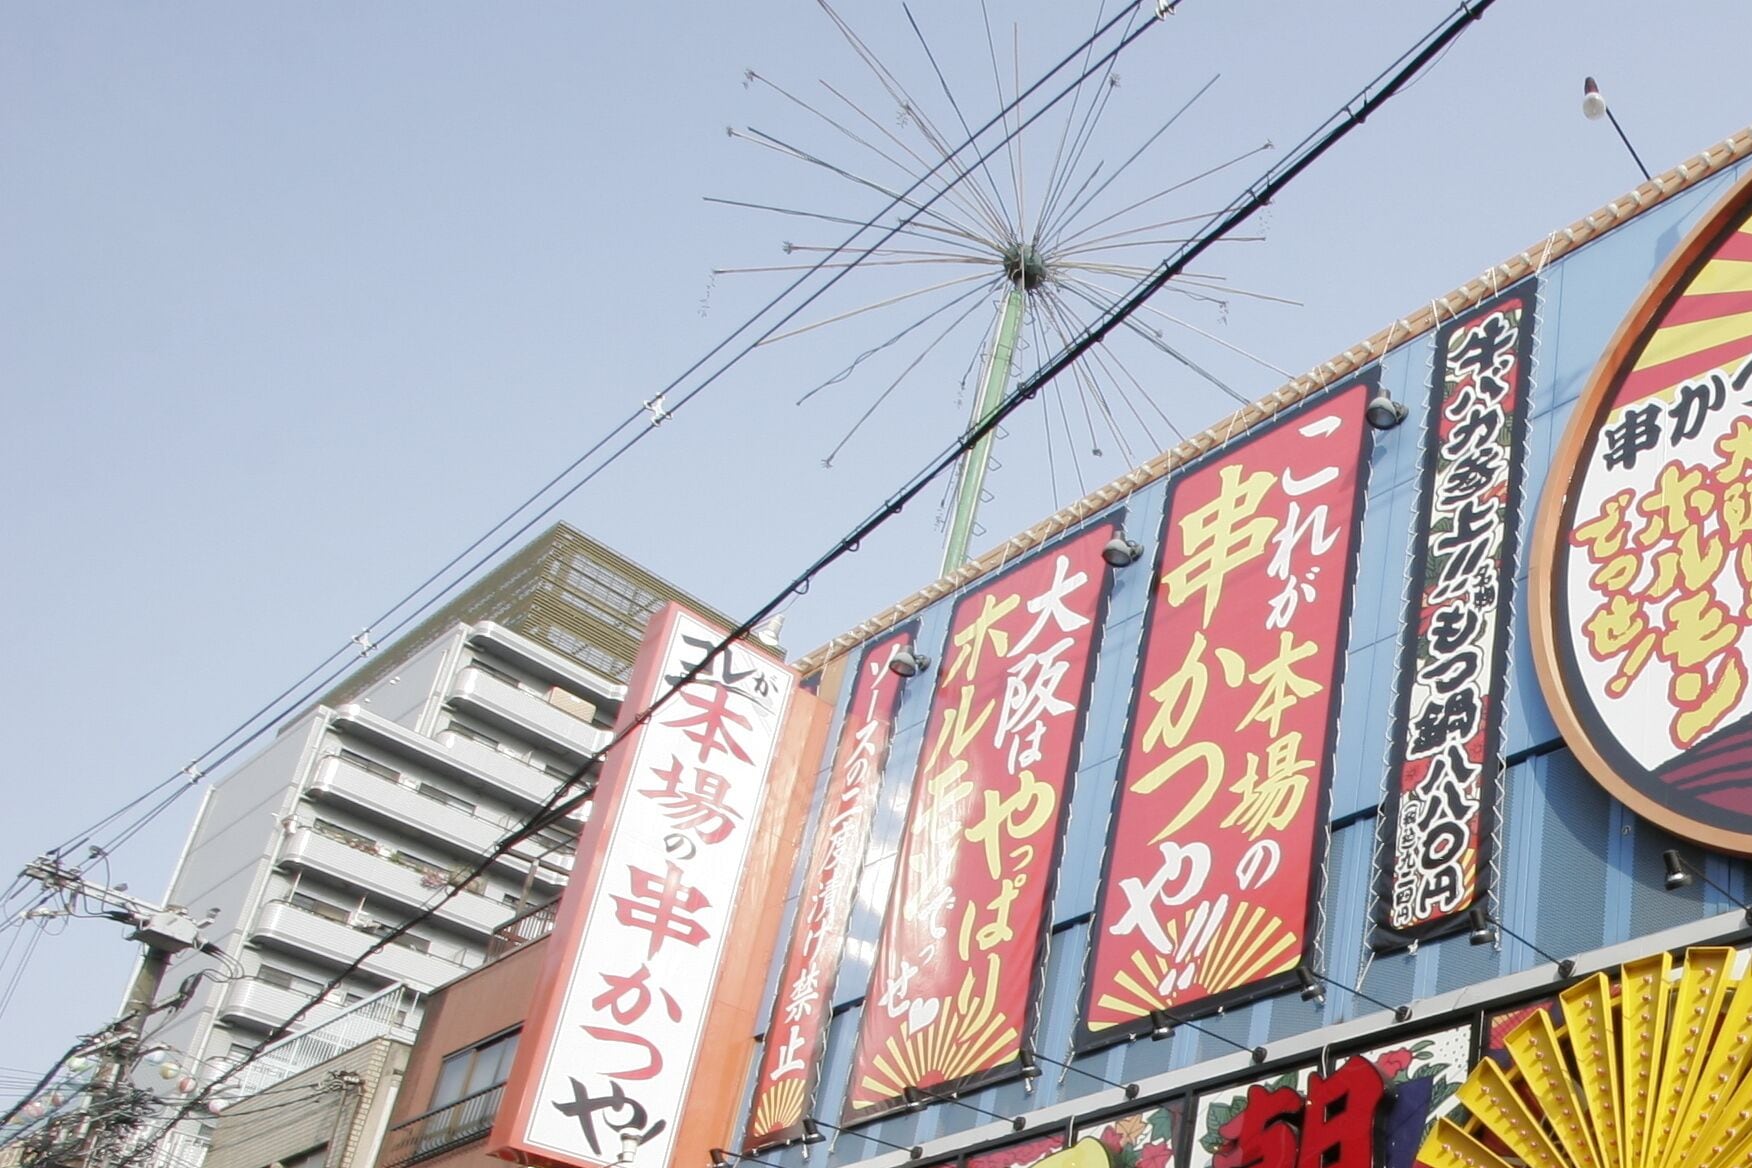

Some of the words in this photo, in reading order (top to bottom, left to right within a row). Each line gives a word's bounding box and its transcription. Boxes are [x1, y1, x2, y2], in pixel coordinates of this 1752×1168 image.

[956, 555, 1090, 1040] 大阪はやっぱり
[1219, 414, 1342, 890] これが本場の
[1642, 462, 1746, 748] ホルモン
